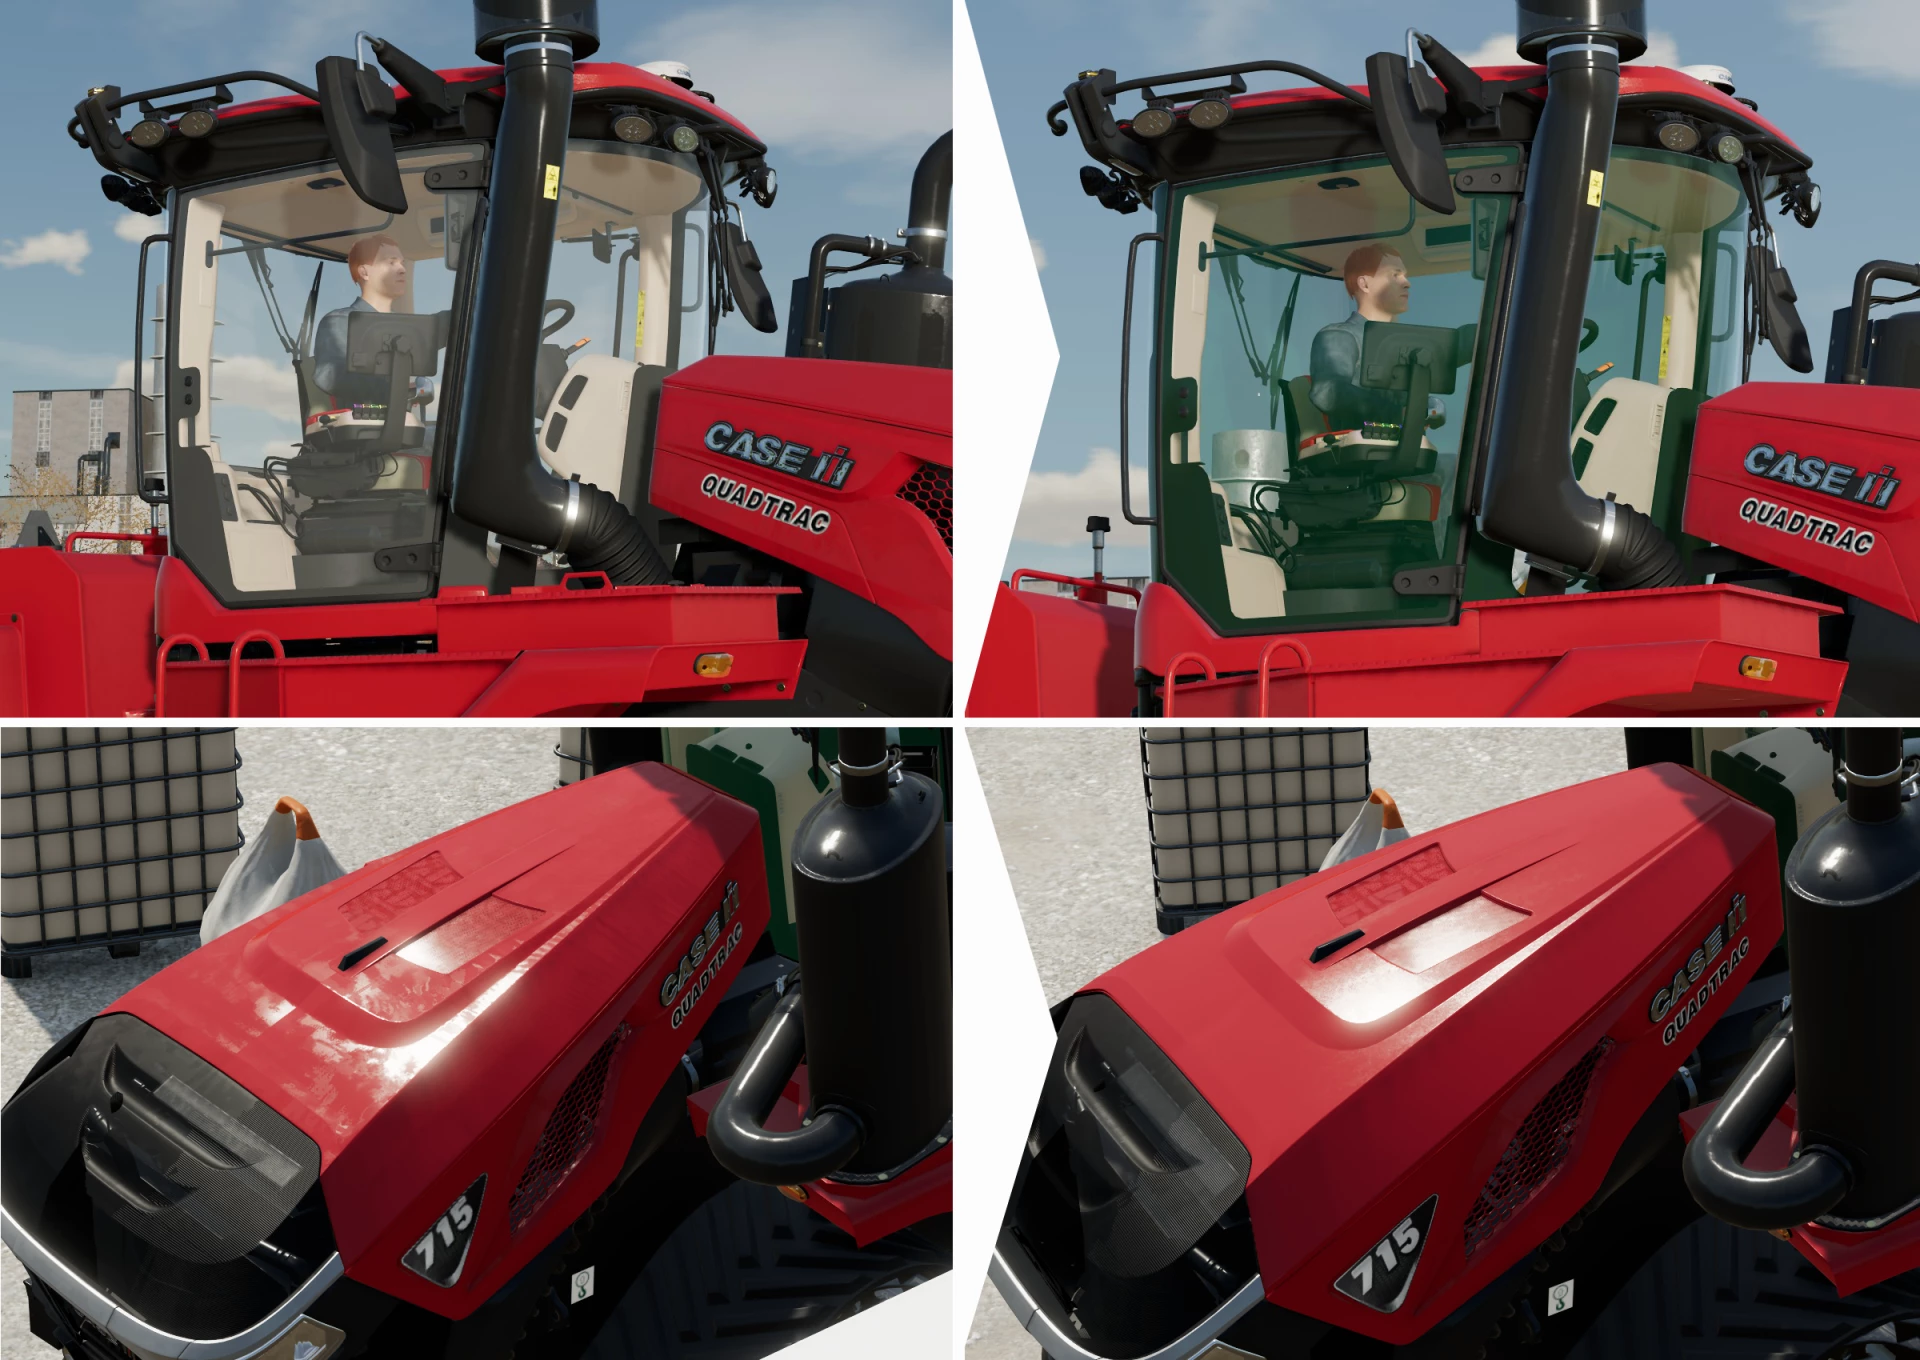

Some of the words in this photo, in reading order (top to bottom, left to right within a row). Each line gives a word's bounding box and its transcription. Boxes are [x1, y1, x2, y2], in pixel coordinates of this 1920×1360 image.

[704, 421, 812, 475] CASE
[1743, 443, 1857, 496] CASE
[701, 473, 831, 535] QUADTRAC
[1739, 497, 1875, 556] QUADTRAC
[660, 911, 721, 1007] CASE
[671, 921, 743, 1030] QUADTRAC
[1648, 922, 1723, 1023] CASE
[1662, 936, 1750, 1046] QUADTRAC
[415, 1195, 473, 1270] 715
[1351, 1217, 1420, 1296] 715
